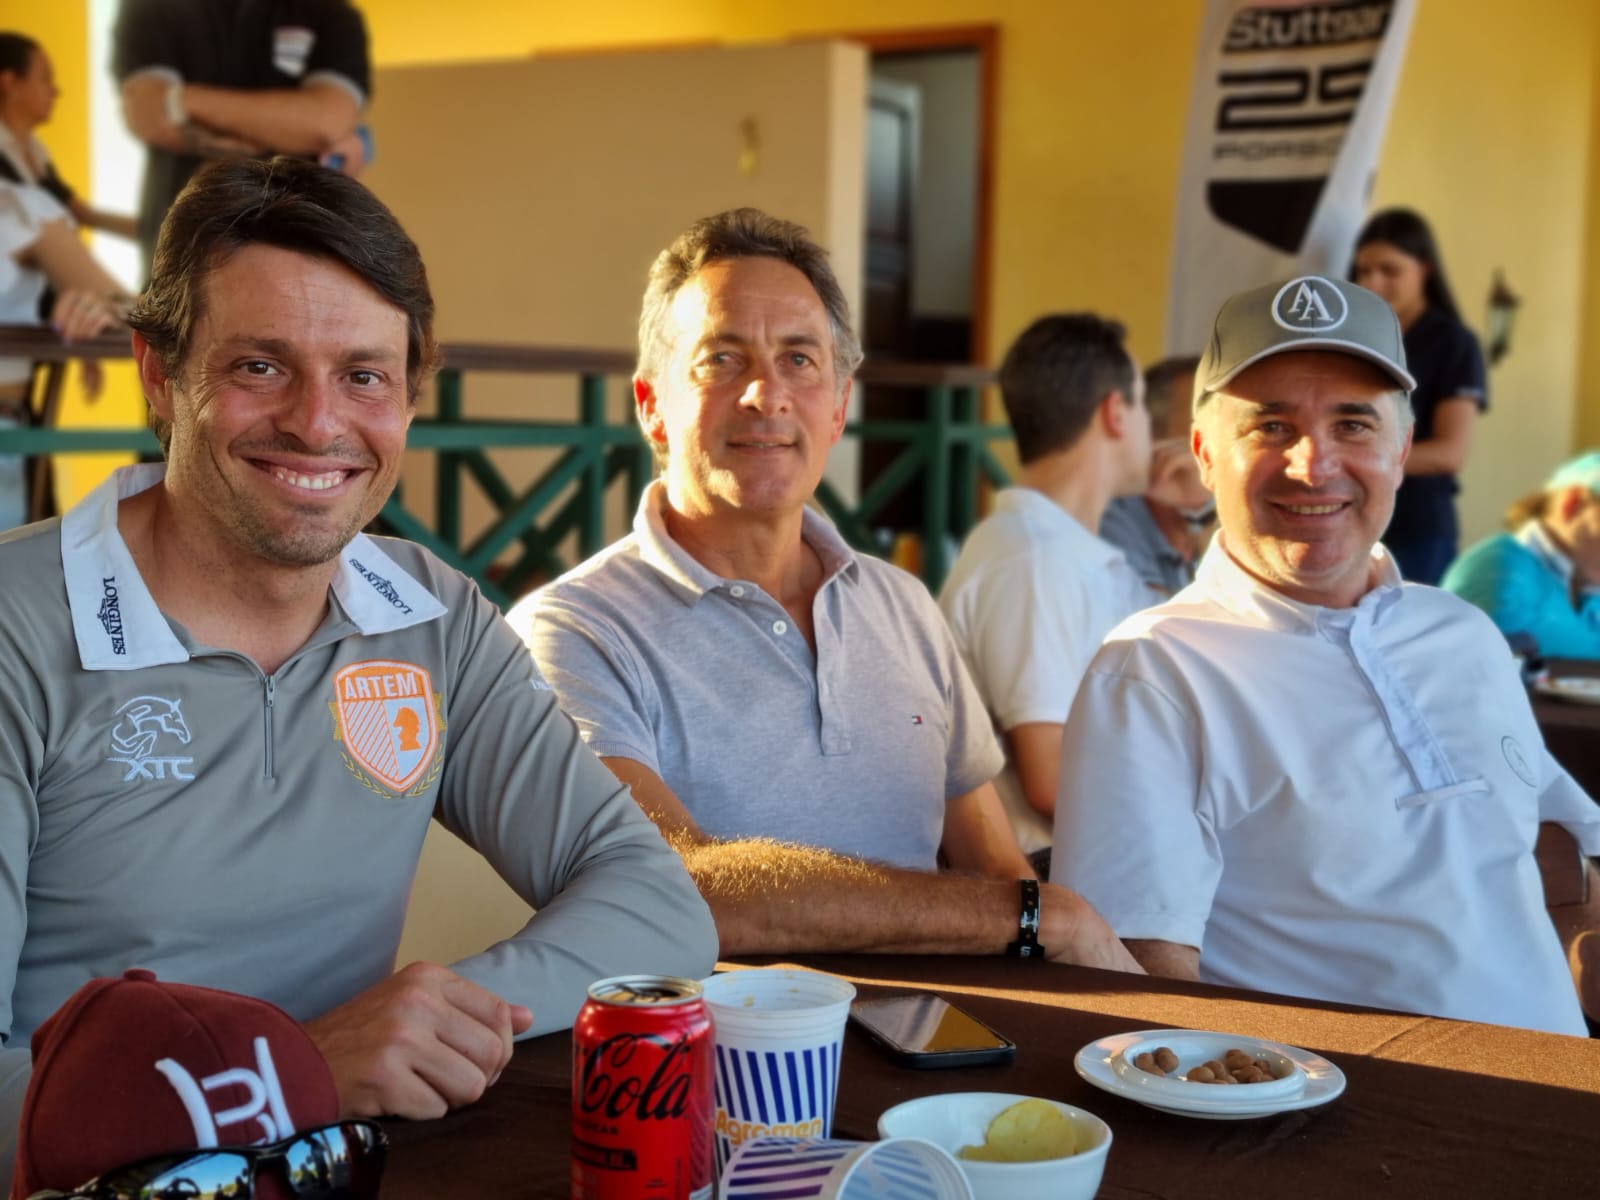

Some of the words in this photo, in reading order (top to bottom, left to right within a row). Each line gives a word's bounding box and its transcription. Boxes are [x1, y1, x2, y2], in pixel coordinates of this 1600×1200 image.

[349, 558, 414, 616] LONGINES
[103, 576, 126, 655] LONGINES
[344, 671, 418, 700] ARTEM
[107, 756, 196, 782] XTC
